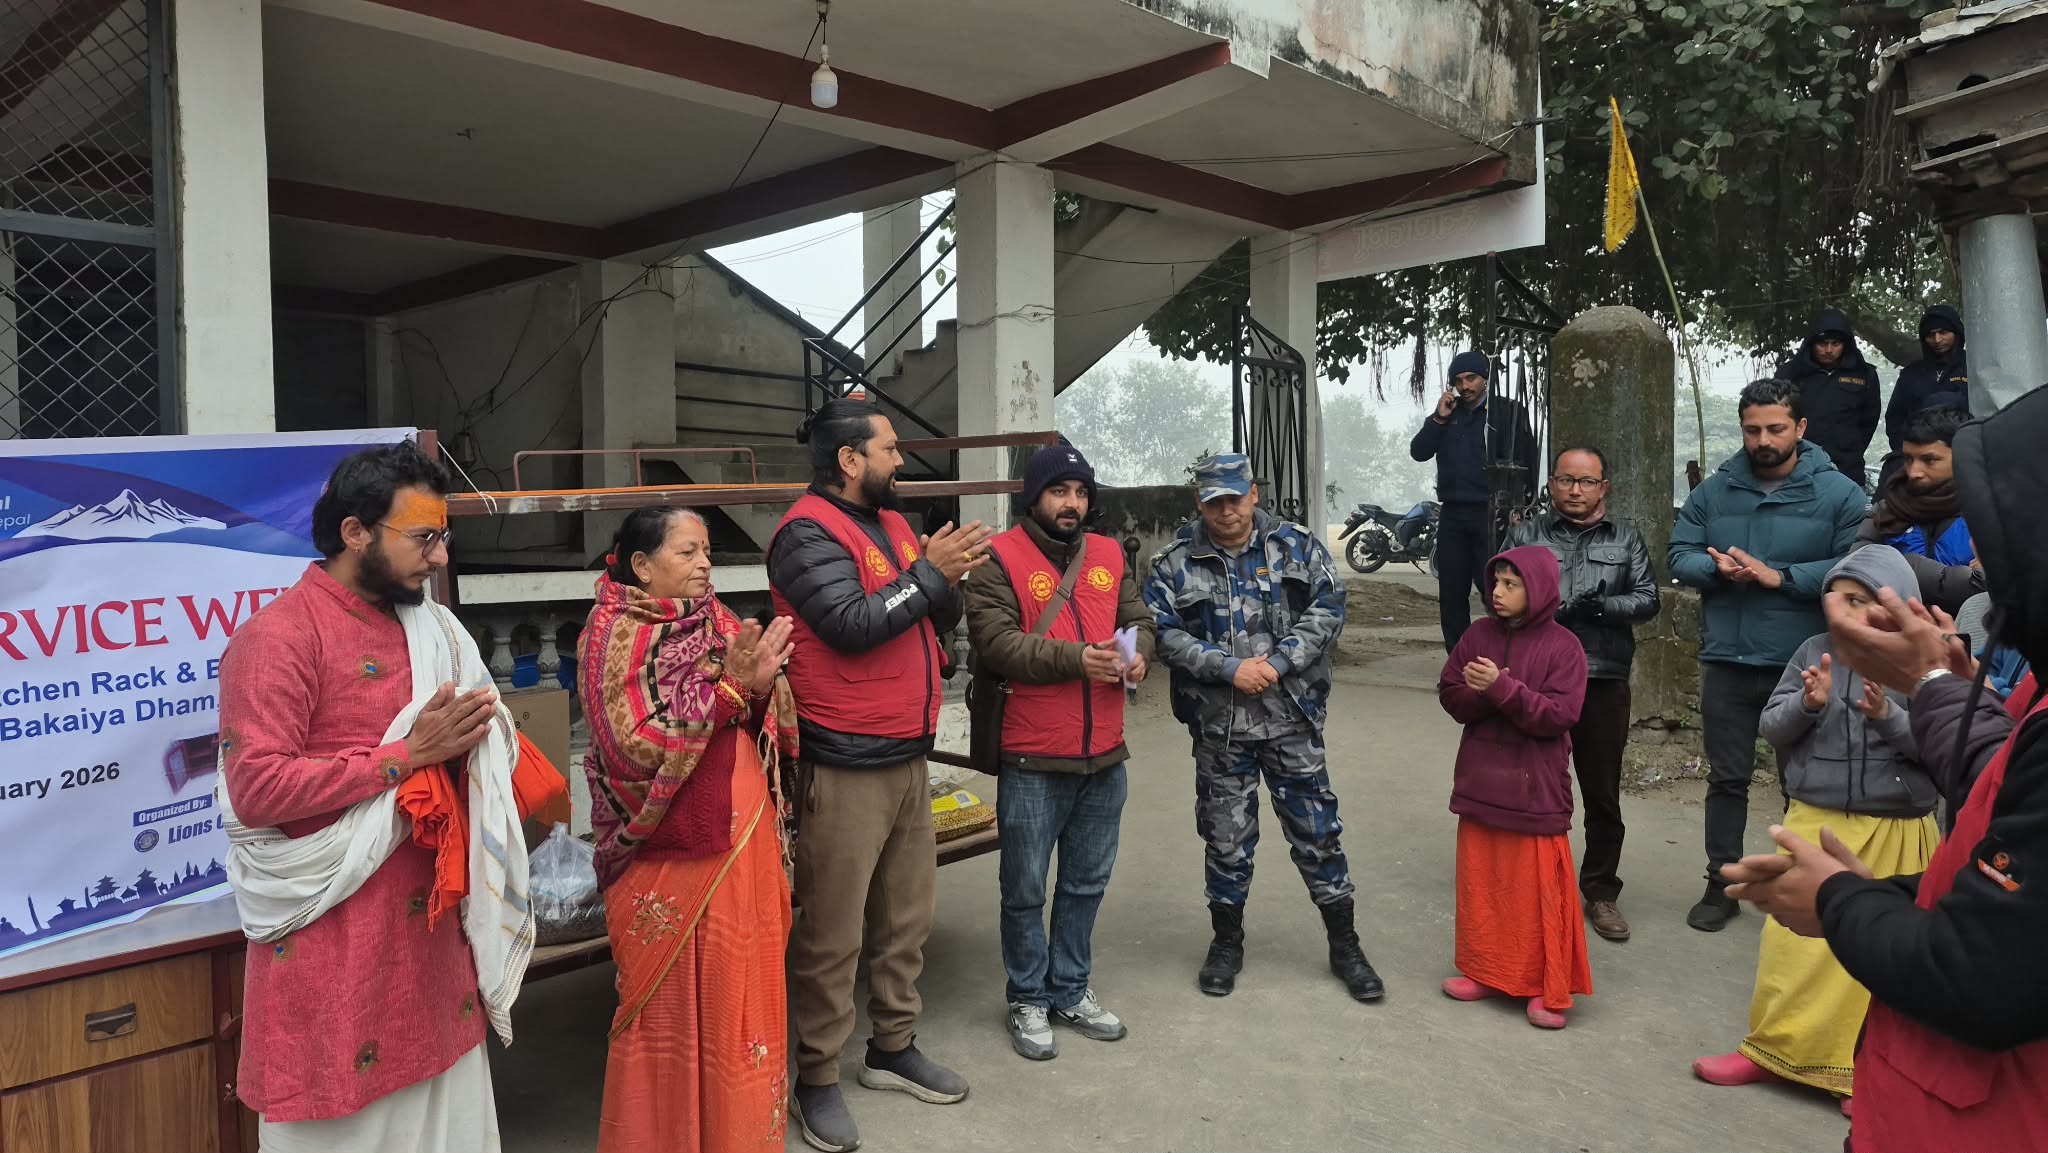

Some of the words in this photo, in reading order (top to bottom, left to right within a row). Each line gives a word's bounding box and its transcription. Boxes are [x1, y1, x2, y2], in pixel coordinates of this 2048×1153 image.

[0, 681, 80, 706] chen
[91, 666, 167, 694] Rack
[176, 661, 197, 683] &
[0, 707, 125, 741] Bakaiya
[60, 761, 120, 790] 2026
[138, 802, 191, 823] Organized
[192, 799, 208, 809] By:
[167, 819, 213, 845] Lions
